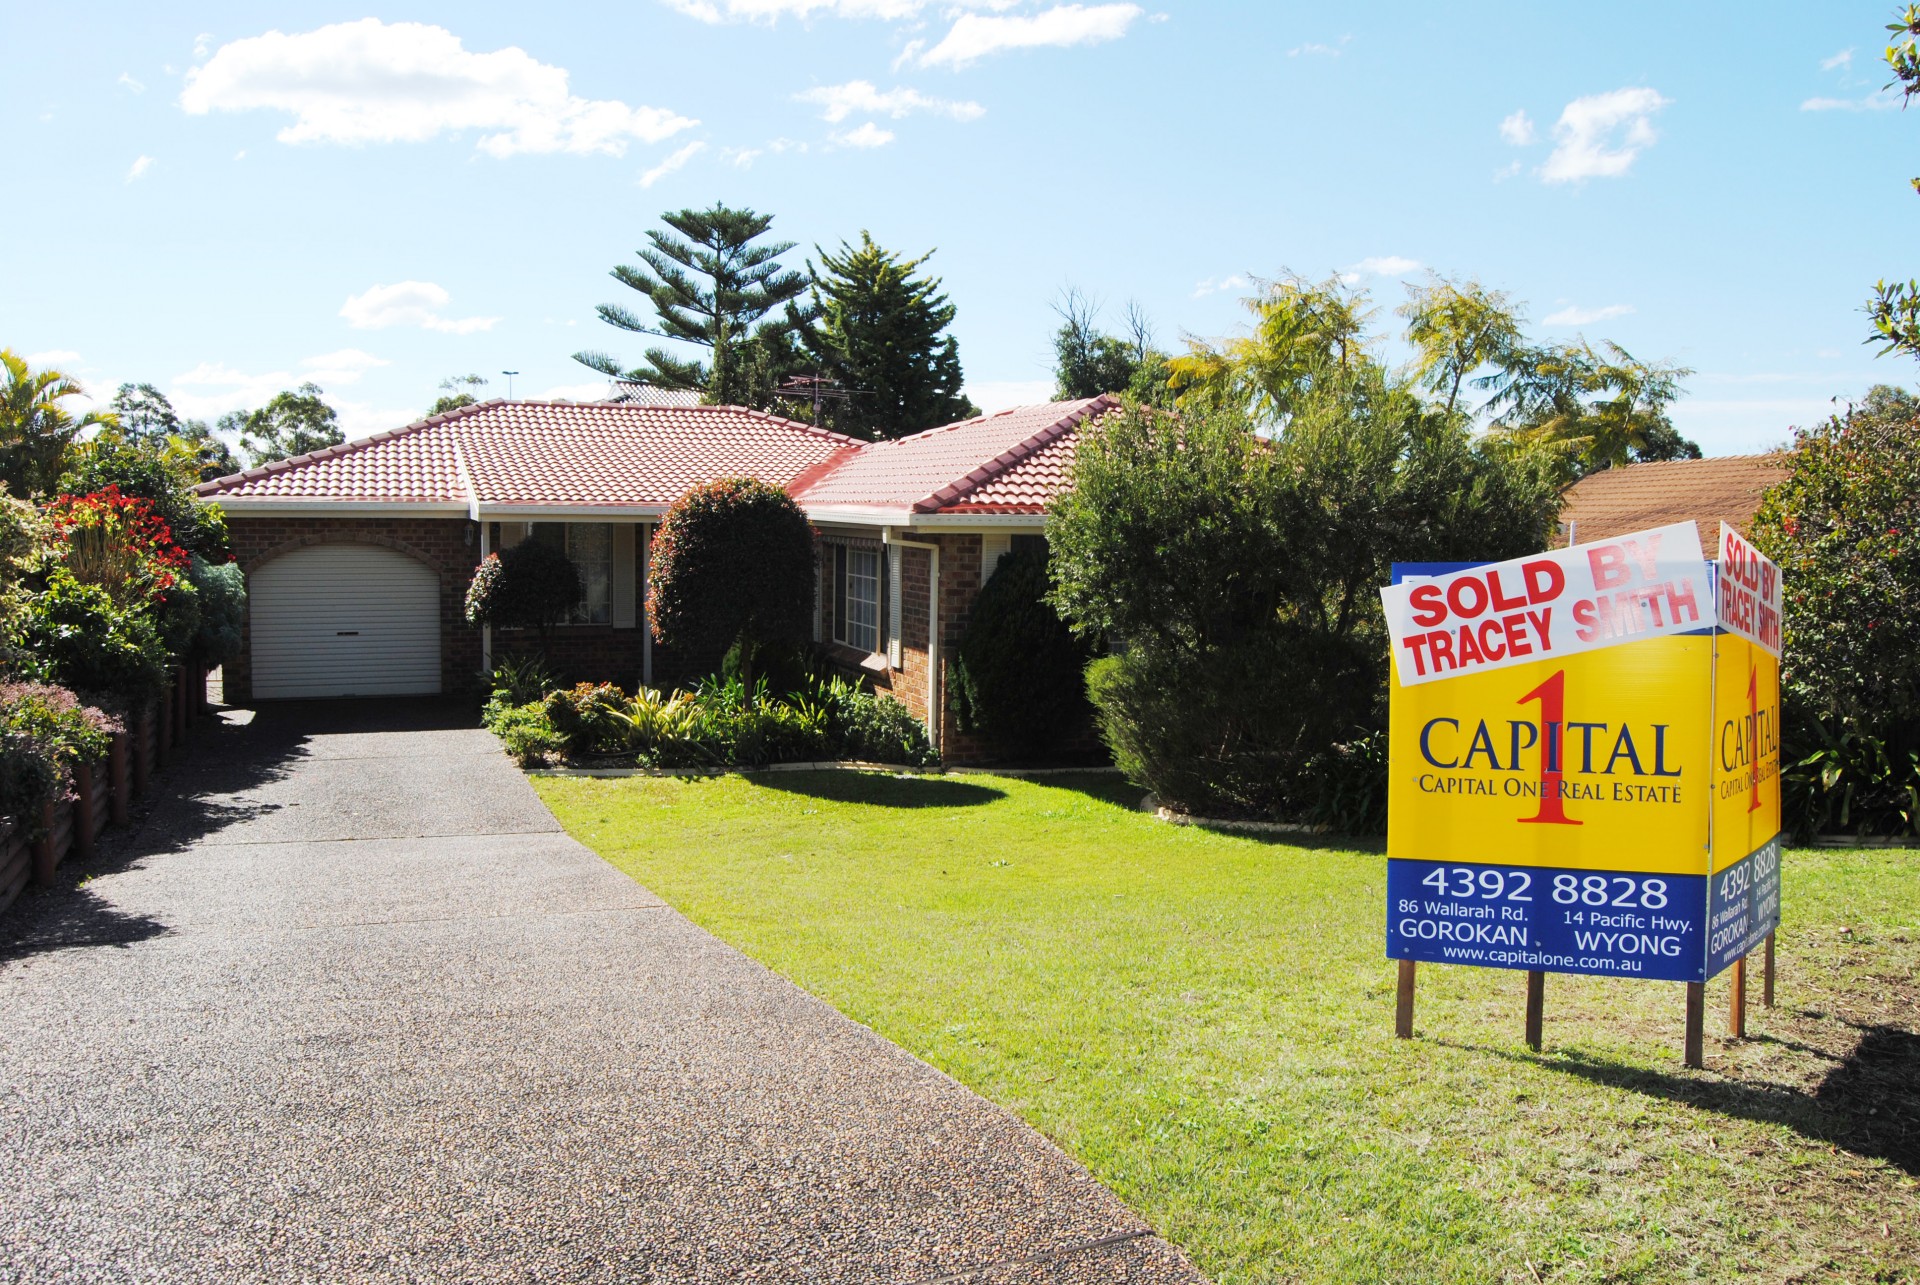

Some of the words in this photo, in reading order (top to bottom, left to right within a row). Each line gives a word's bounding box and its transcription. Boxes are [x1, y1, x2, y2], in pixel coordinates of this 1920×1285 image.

[1409, 559, 1565, 627] SOLD
[1587, 533, 1663, 591] BY
[1725, 533, 1758, 592] SOLD
[1762, 561, 1776, 604] BY
[1402, 607, 1552, 676] TRACEY
[1572, 577, 1700, 643] SMITH
[1721, 577, 1755, 635] TRACEY
[1759, 601, 1779, 651] SMITH
[1419, 717, 1682, 777] CAPITAL
[1721, 705, 1777, 772] CAPITAL
[1422, 867, 1533, 901] 4392
[1552, 874, 1668, 909] 8828
[1720, 861, 1751, 902] 4392
[1754, 842, 1776, 882] 8828
[1398, 899, 1419, 913] 86
[1424, 901, 1495, 919] Wallarah
[1502, 907, 1529, 922] Rd.
[1563, 911, 1584, 925] 14
[1591, 912, 1645, 929] Pacific
[1652, 916, 1693, 934] Hwy.
[1711, 914, 1719, 930] 86
[1720, 902, 1741, 924] Wallarah
[1757, 889, 1778, 922] WYONG
[1399, 918, 1528, 947] GOROKAN
[1574, 930, 1681, 956] WYONG
[1710, 913, 1749, 955] GOROKAN
[1443, 946, 1642, 972] www.capitalone.com.au
